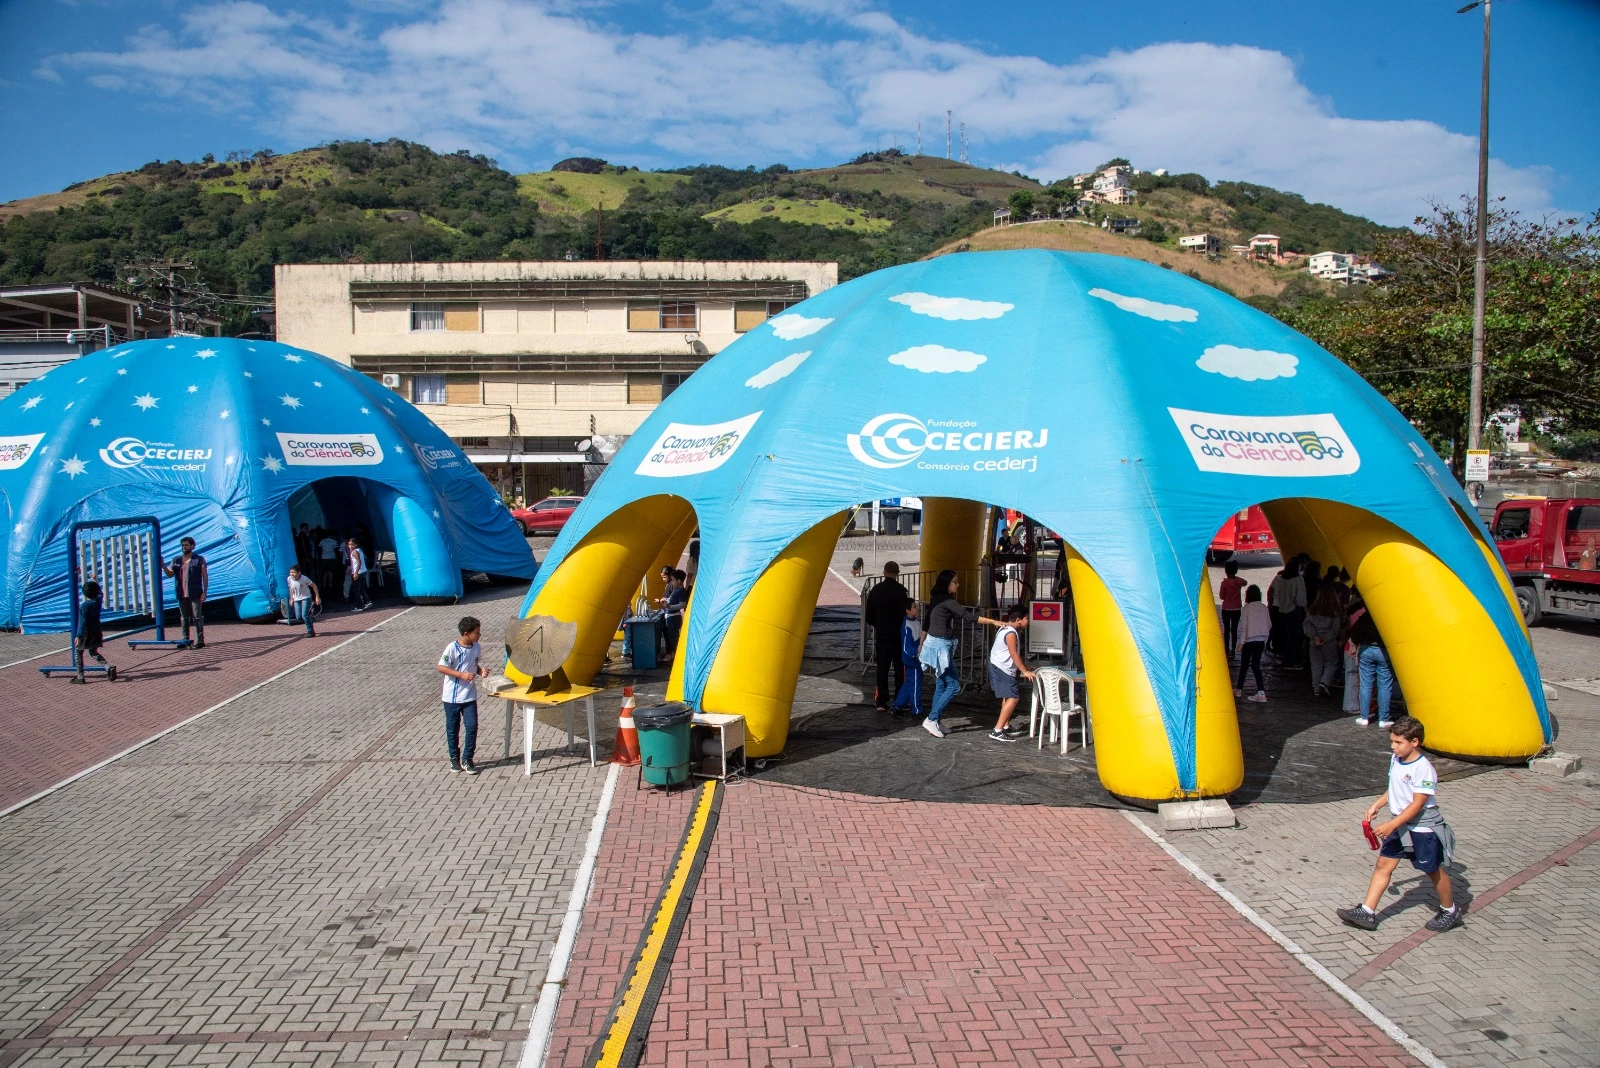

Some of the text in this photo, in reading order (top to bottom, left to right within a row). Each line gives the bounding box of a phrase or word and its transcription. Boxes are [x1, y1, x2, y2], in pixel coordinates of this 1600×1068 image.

[927, 419, 977, 428] Fundação
[925, 428, 1049, 451] CECIERJ
[1190, 424, 1295, 444] Caravana
[287, 440, 350, 449] Caravana
[662, 435, 720, 449] Caravana
[144, 448, 213, 460] CECIERJ
[291, 448, 353, 458] da Ciência
[651, 448, 708, 464] da Ciência
[1201, 442, 1305, 461] da Ciência
[171, 463, 206, 472] cederj
[917, 455, 1038, 473] Consórcio cederj
